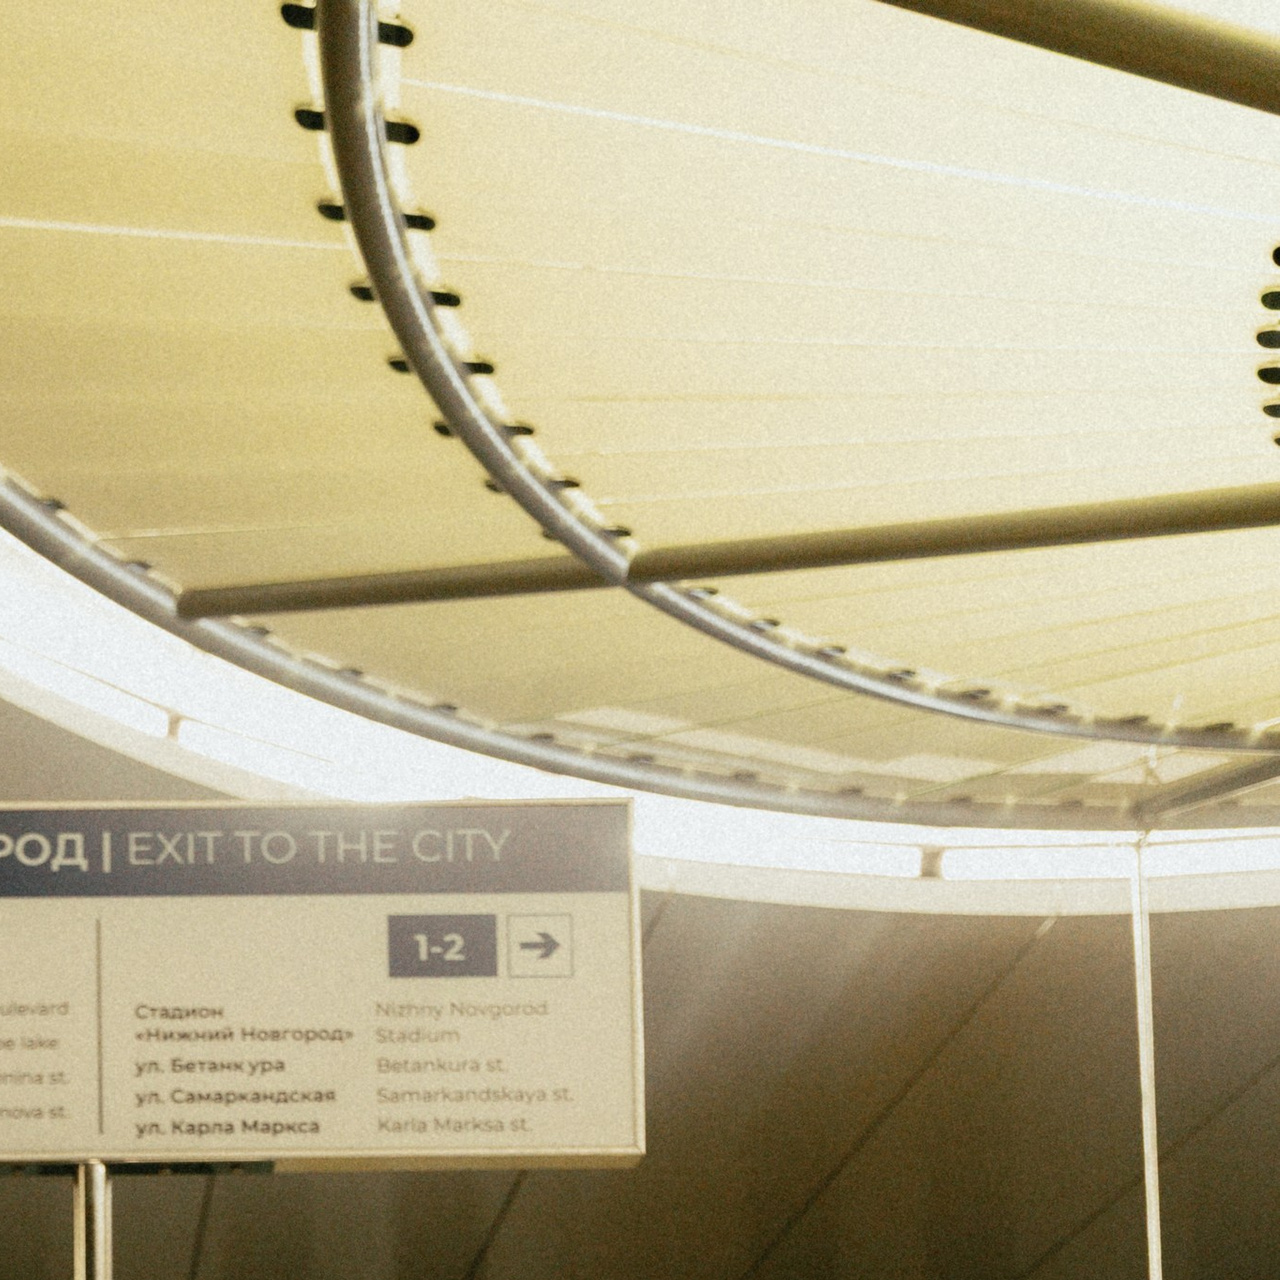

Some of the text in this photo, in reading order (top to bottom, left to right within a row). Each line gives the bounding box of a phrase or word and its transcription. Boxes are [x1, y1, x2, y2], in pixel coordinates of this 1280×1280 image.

[128, 828, 511, 866] EXIT TO THE CITY
[413, 933, 466, 961] 1-2
[135, 1004, 223, 1019] Стадион
[375, 1000, 549, 1021] Nizhny Novgorod
[375, 1027, 460, 1043] Stadium
[135, 1057, 286, 1077] ул. Бетанкура
[376, 1056, 480, 1074] Betankura
[170, 1089, 336, 1106] Самаркандская
[376, 1086, 575, 1105] Samarkandskaya st.
[135, 1119, 320, 1138] ул. Карла Маркса
[377, 1117, 427, 1133] Karla
[433, 1116, 505, 1133] Marksa
